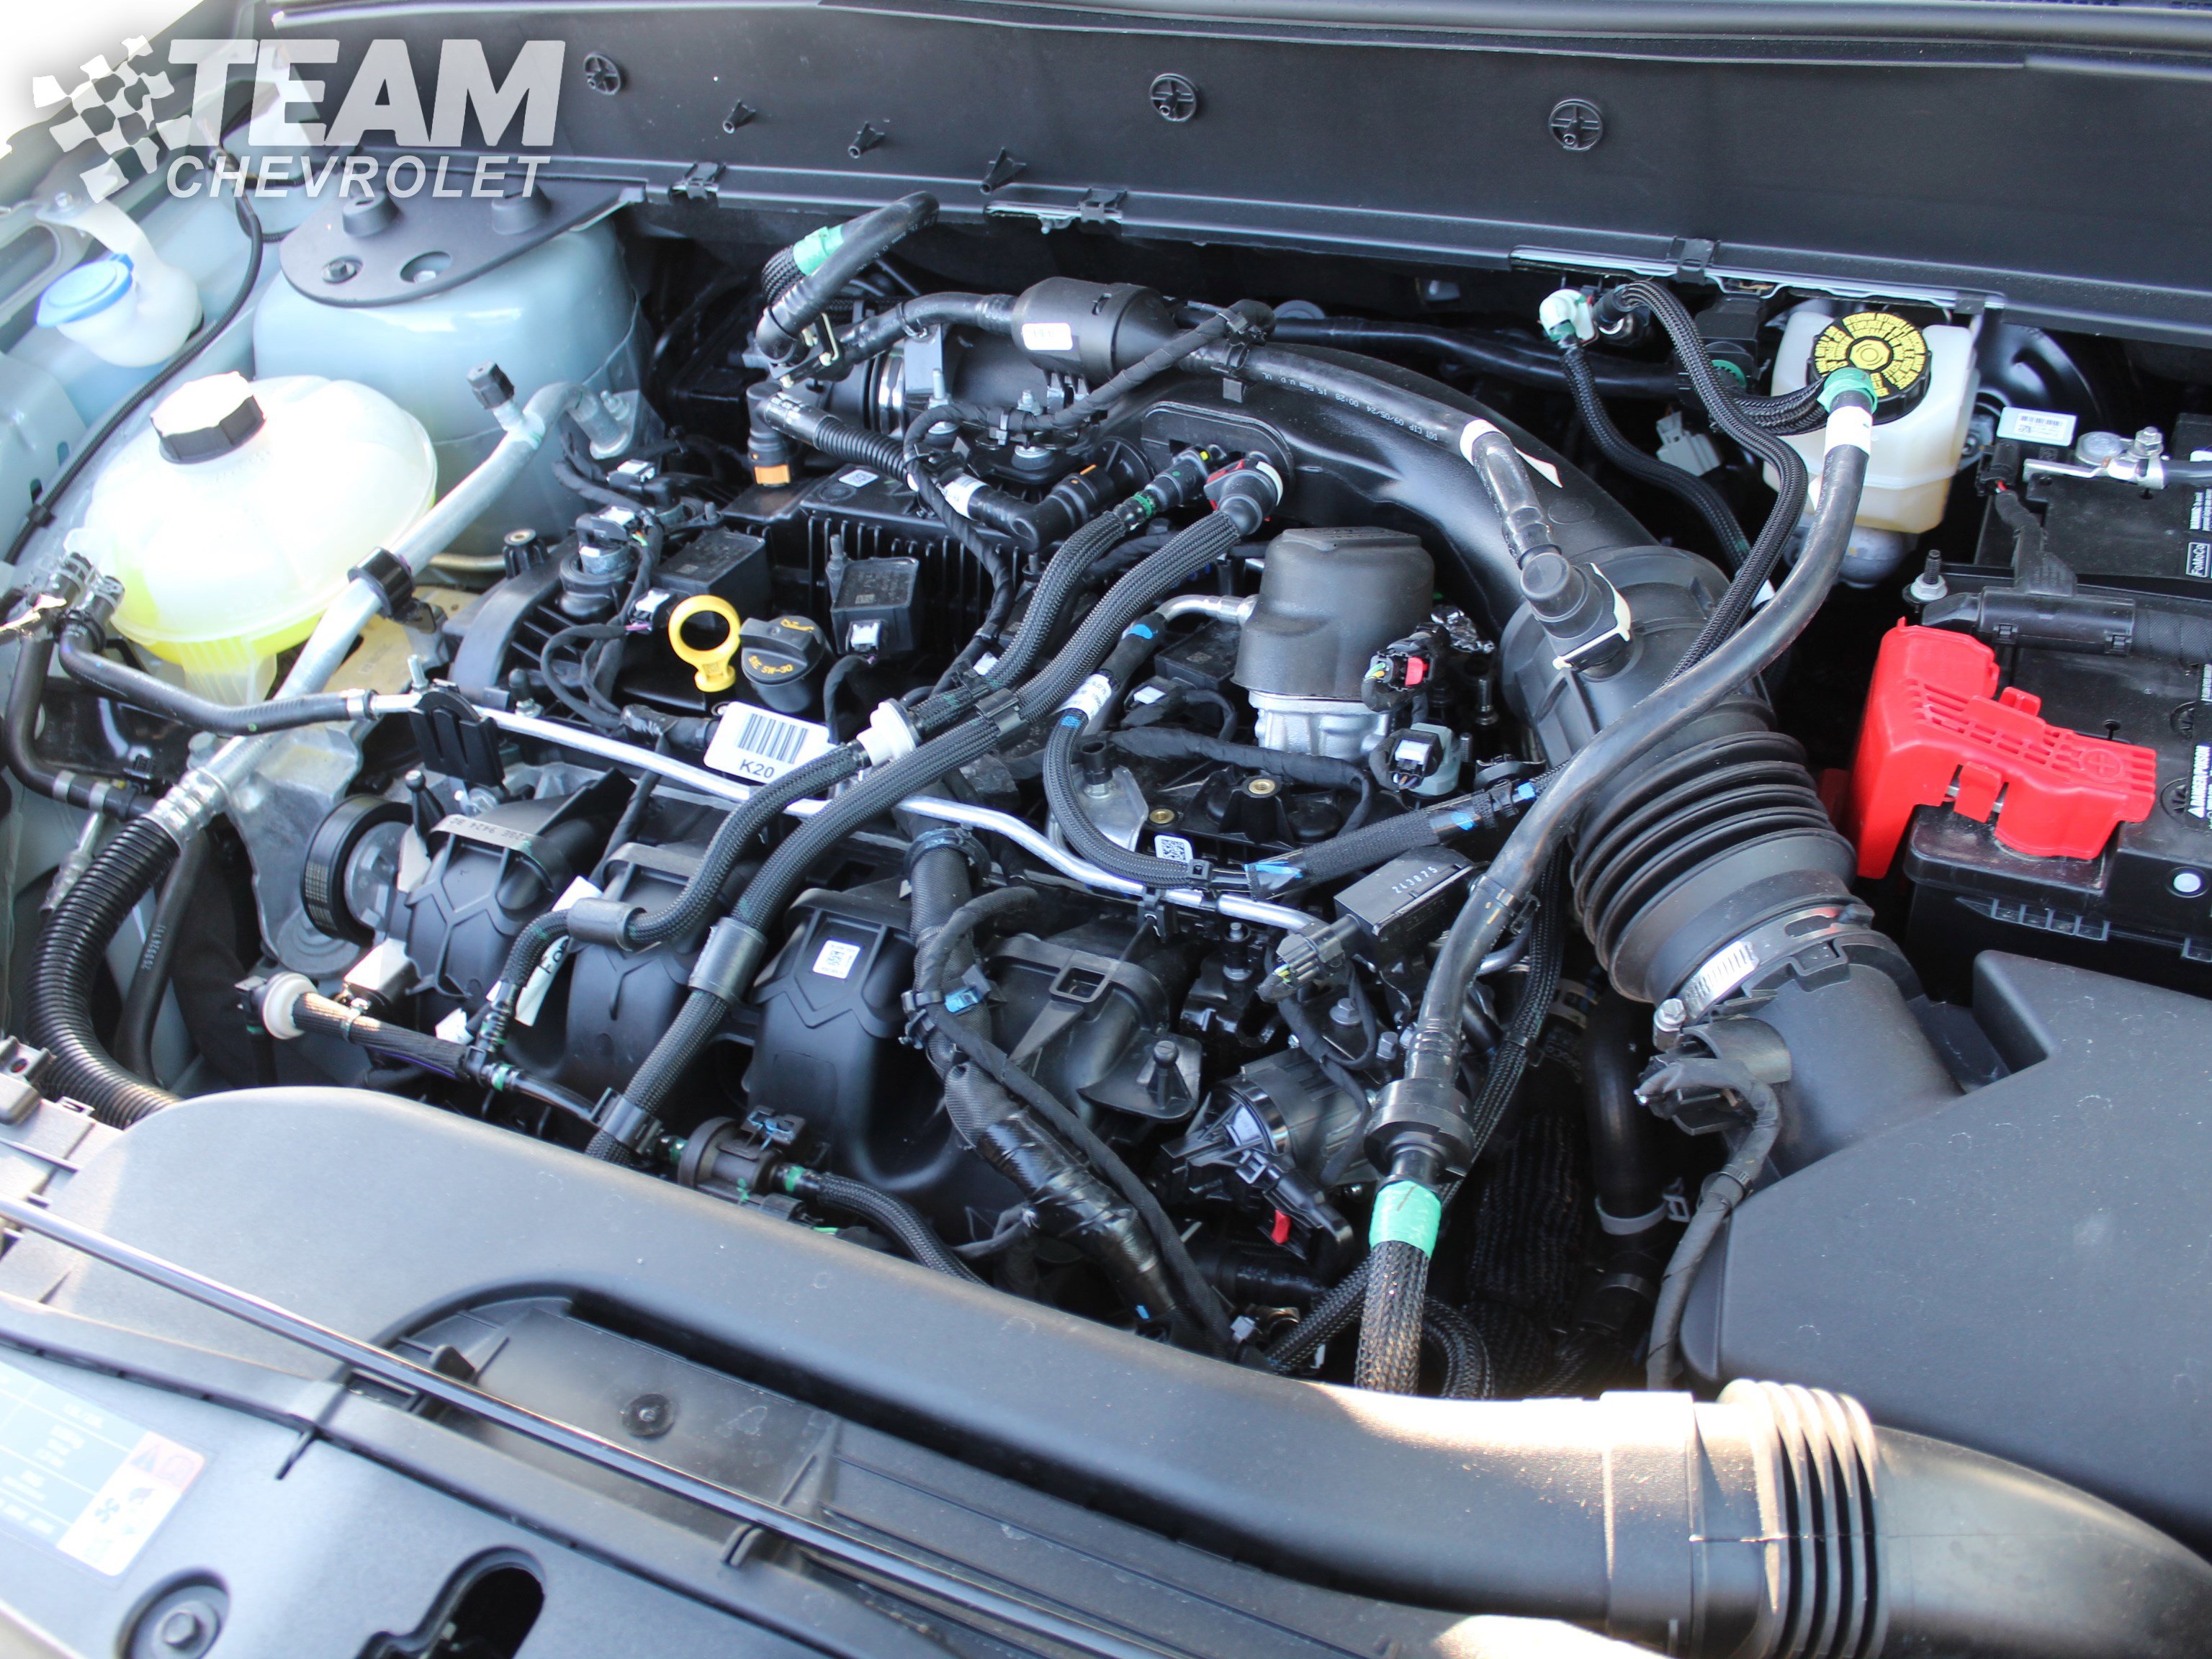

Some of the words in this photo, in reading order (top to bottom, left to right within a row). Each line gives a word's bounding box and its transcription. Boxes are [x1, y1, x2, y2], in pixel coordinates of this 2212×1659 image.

[2190, 544, 2206, 577] FoMoCo
[761, 663, 793, 675] 5W-30
[739, 758, 775, 779] K20
